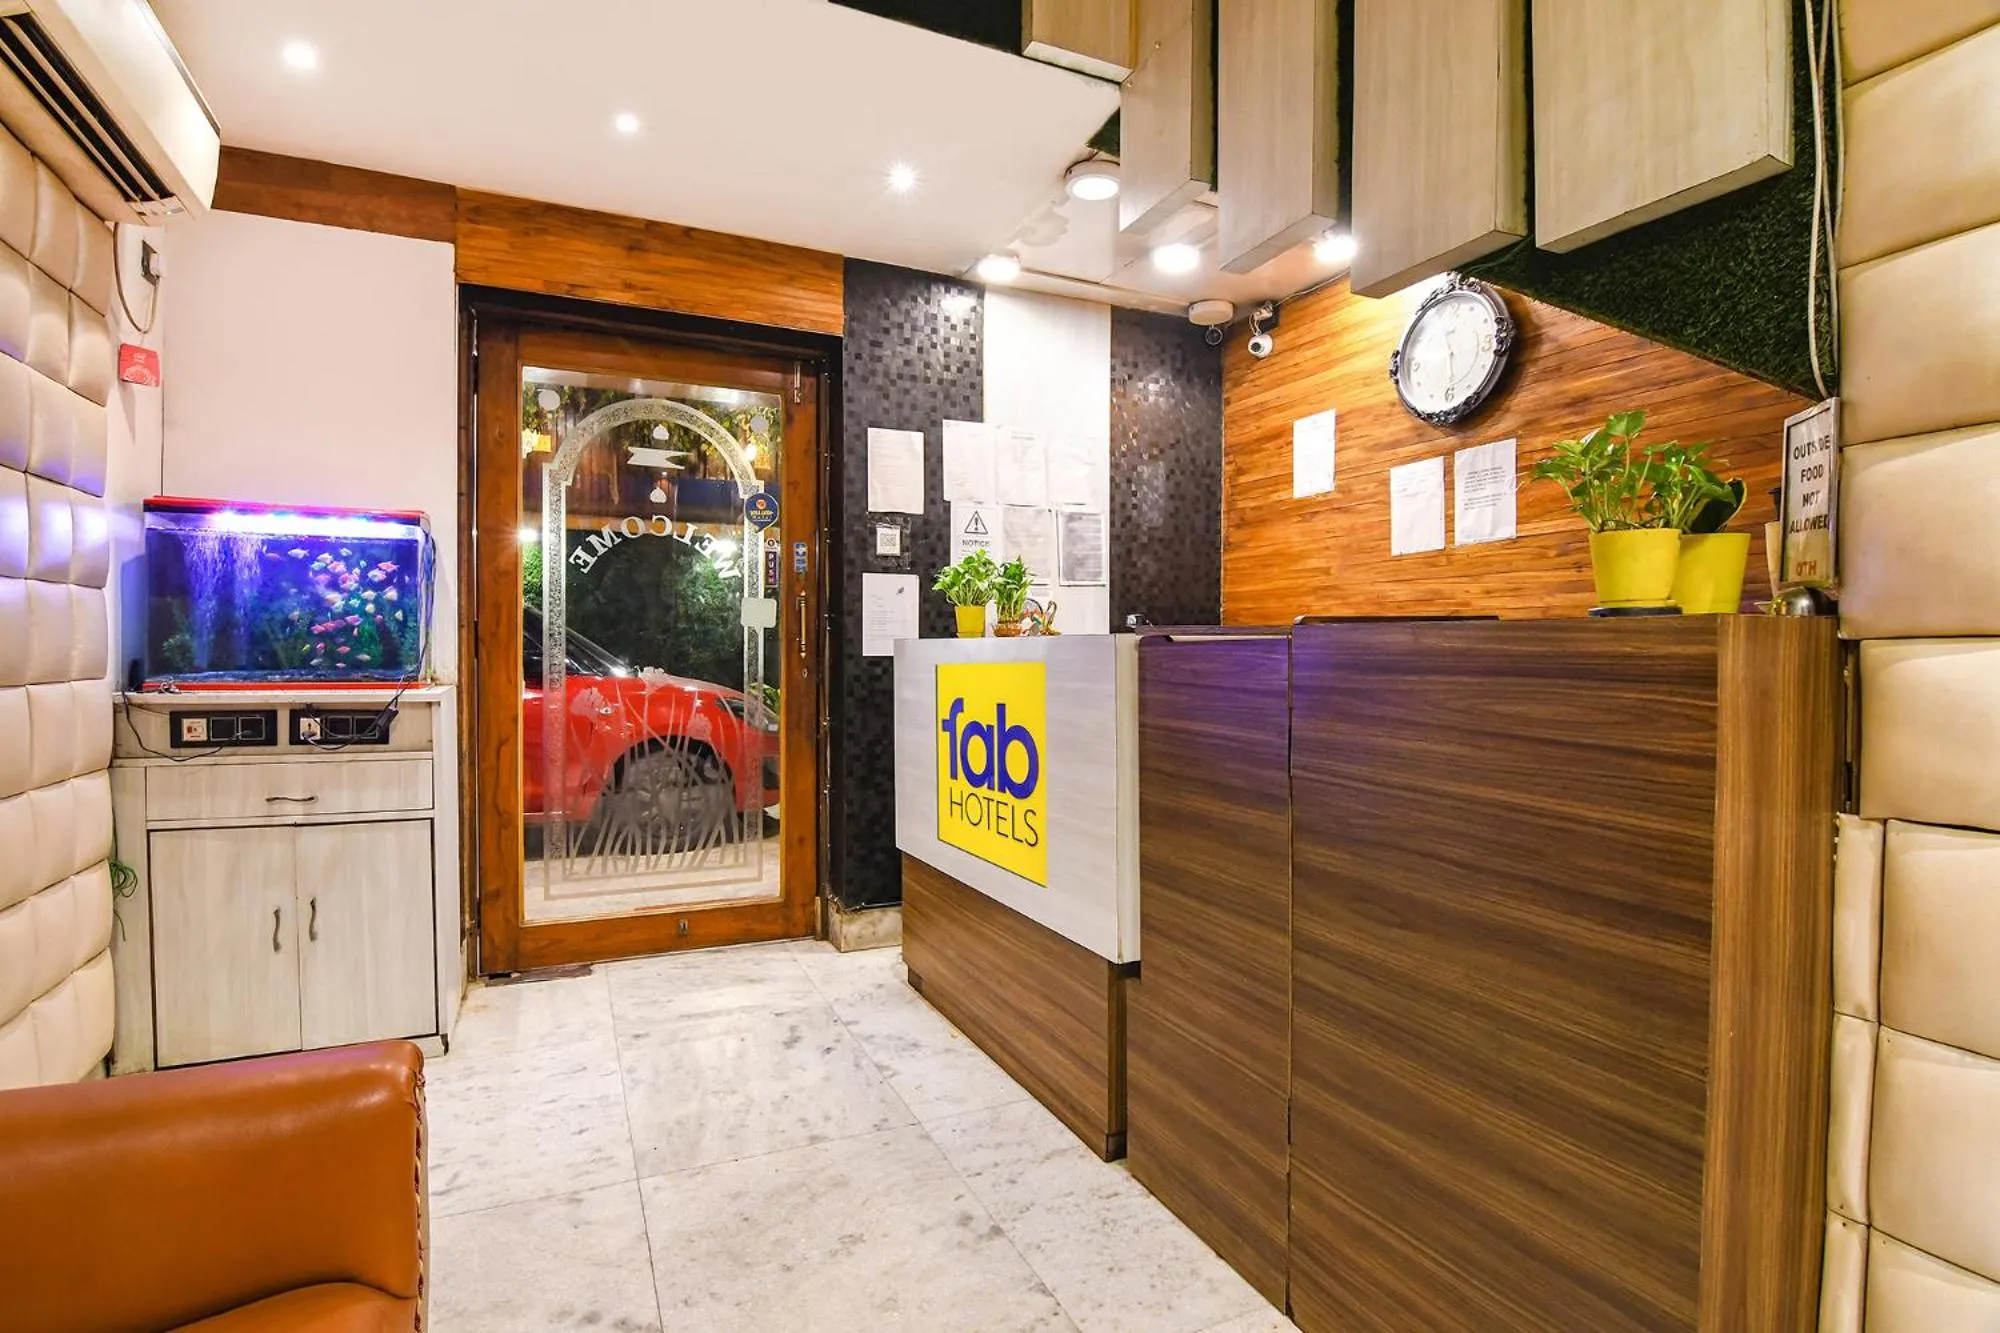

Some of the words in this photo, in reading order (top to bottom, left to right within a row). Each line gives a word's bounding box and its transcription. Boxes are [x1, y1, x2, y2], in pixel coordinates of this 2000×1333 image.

[1793, 434, 1830, 460] OUTSDE
[1800, 463, 1824, 483] FOOD
[1802, 490, 1820, 507] NOT
[962, 539, 991, 548] NOTICE
[941, 697, 1039, 800] fab
[950, 786, 1039, 847] HOTELS
